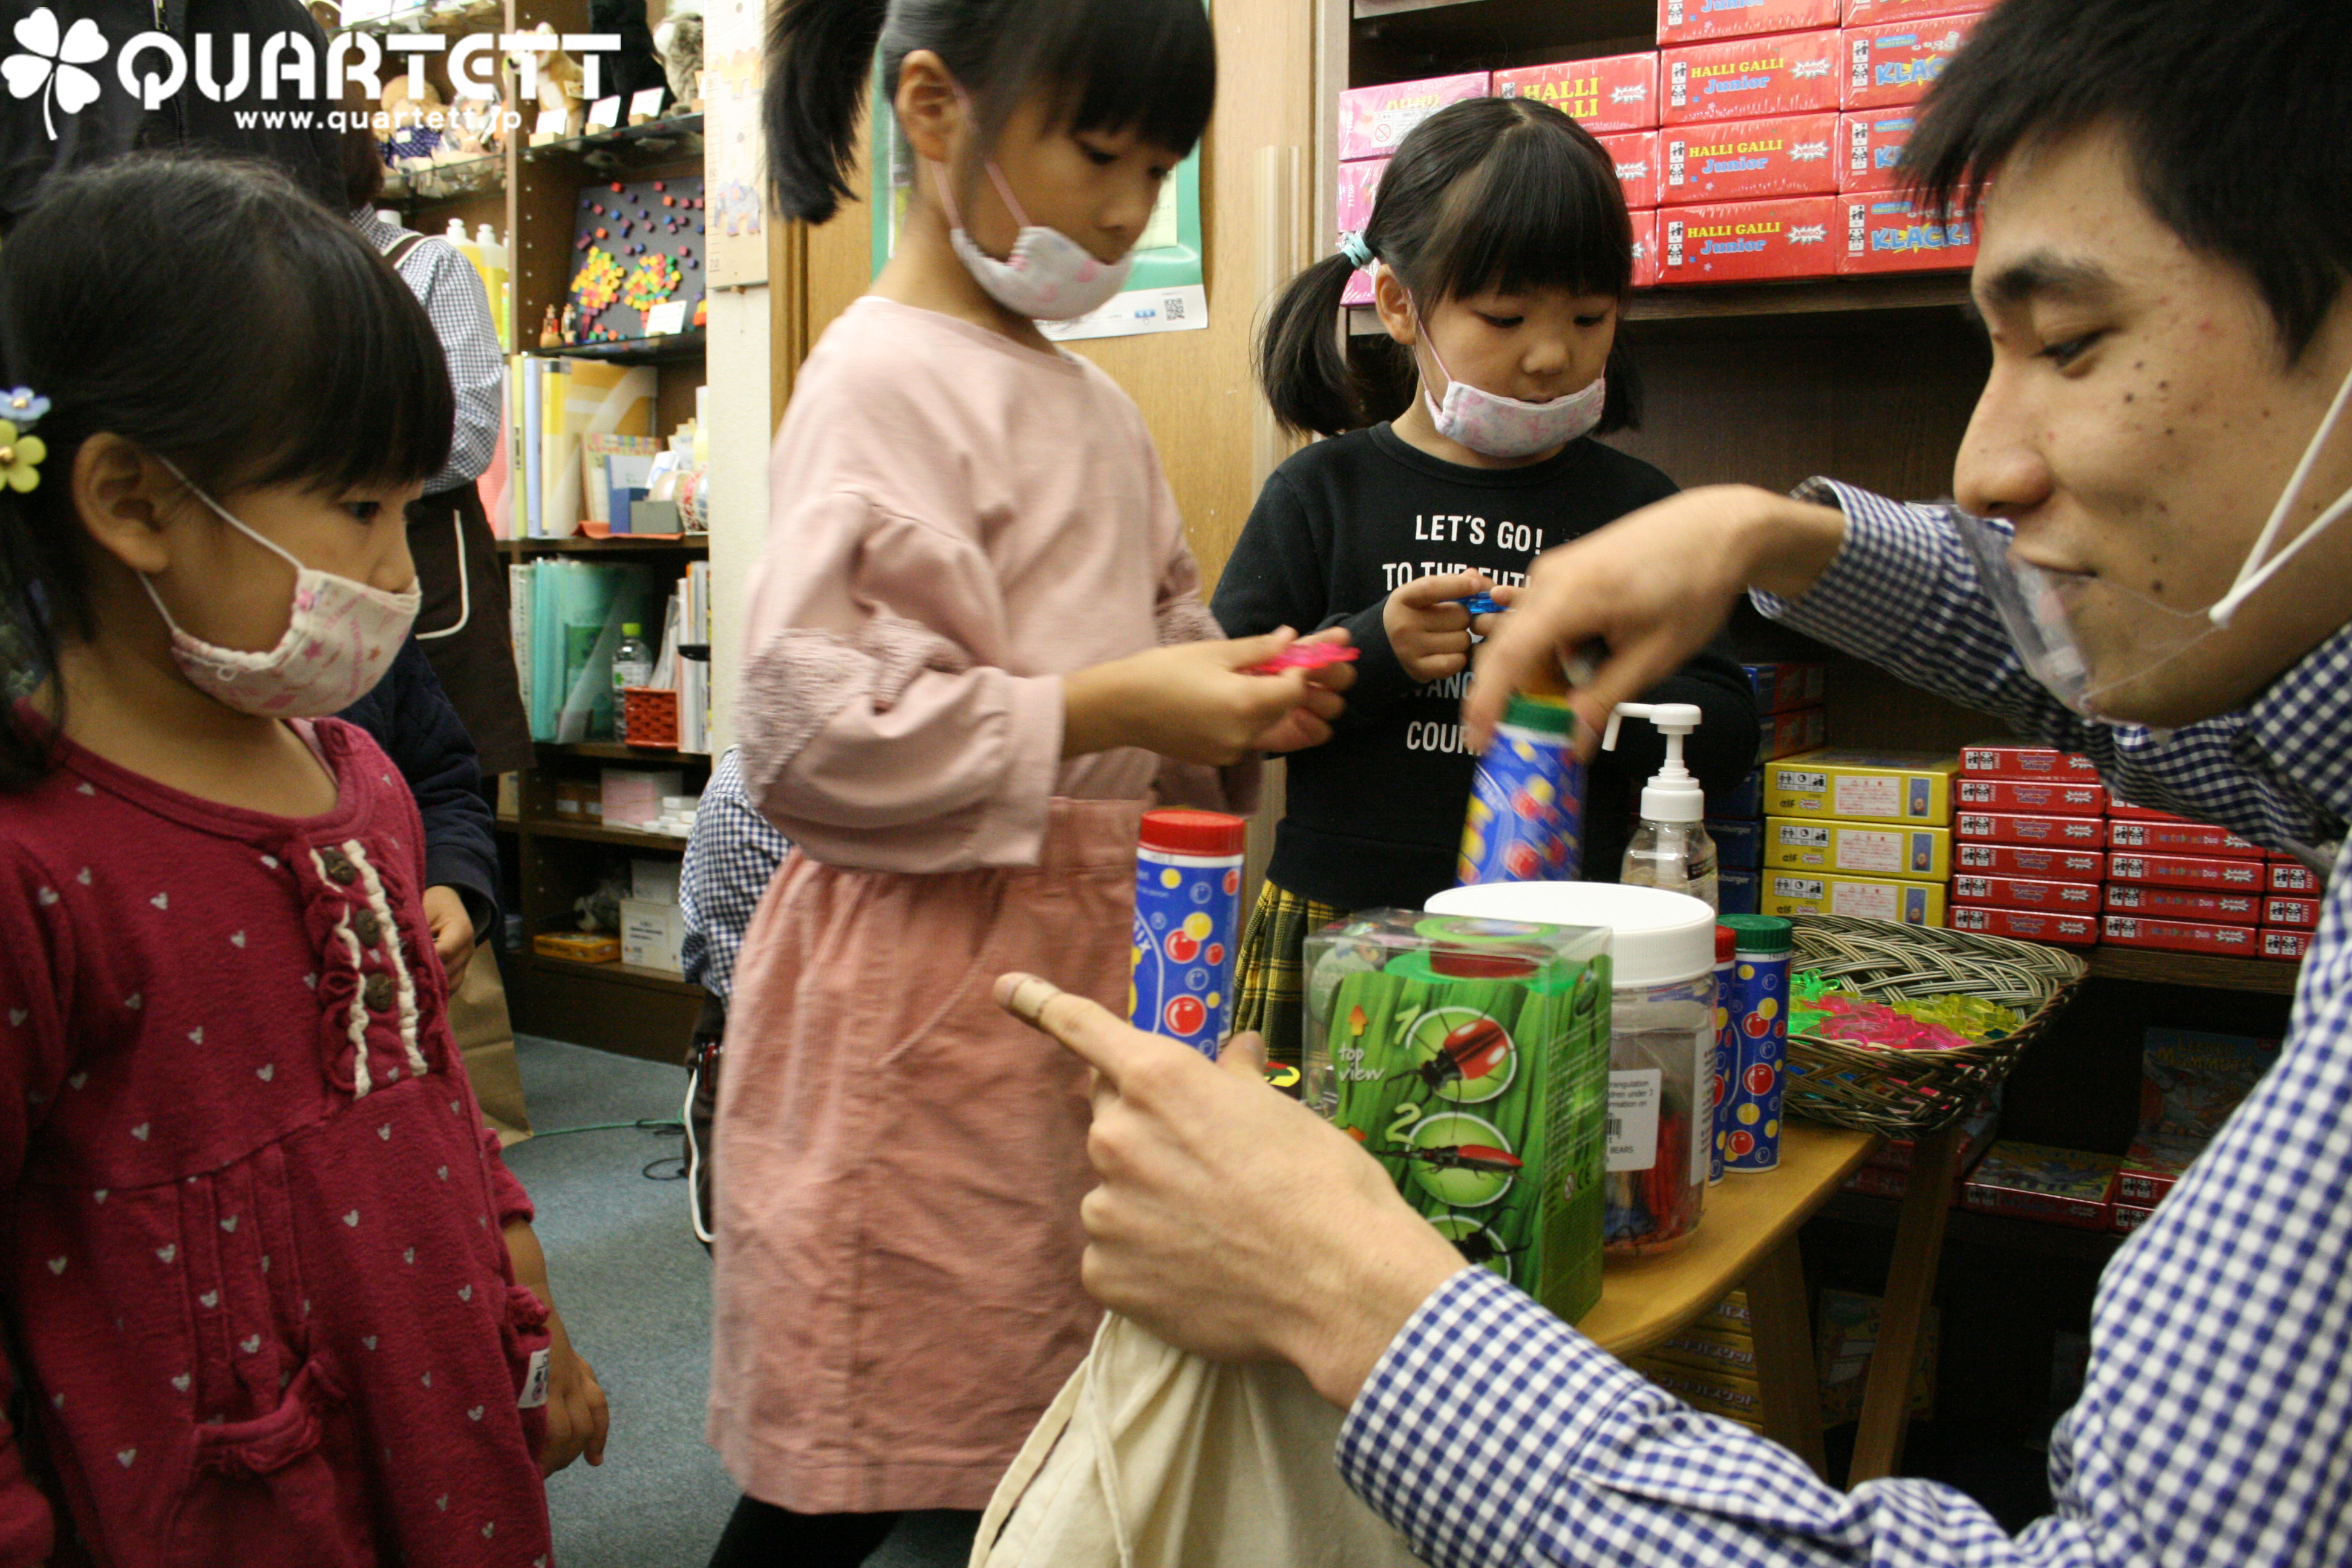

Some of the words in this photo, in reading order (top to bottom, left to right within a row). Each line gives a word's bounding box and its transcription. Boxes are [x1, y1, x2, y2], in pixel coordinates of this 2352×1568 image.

[1690, 63, 1735, 78] HALLI
[1739, 57, 1784, 73] GALLI
[1875, 57, 1947, 86] KLAC
[1523, 77, 1599, 101] HALLI
[1704, 76, 1770, 94] Junior
[1547, 98, 1599, 118] LLI
[1688, 144, 1734, 157] HALLI
[1737, 139, 1783, 154] GALLI
[1702, 157, 1768, 174] Junior
[1687, 225, 1732, 238] HALLI
[1736, 221, 1781, 235] GALLI
[1871, 222, 1971, 251] KLACK!
[1700, 238, 1766, 254] Junior
[1416, 515, 1485, 544] LET'S
[1497, 521, 1542, 555] GO!
[1382, 562, 1413, 591] TO
[1395, 1004, 1421, 1045] 1
[1338, 1042, 1365, 1068] top
[1338, 1063, 1385, 1082] view
[1385, 1103, 1422, 1145] 2
